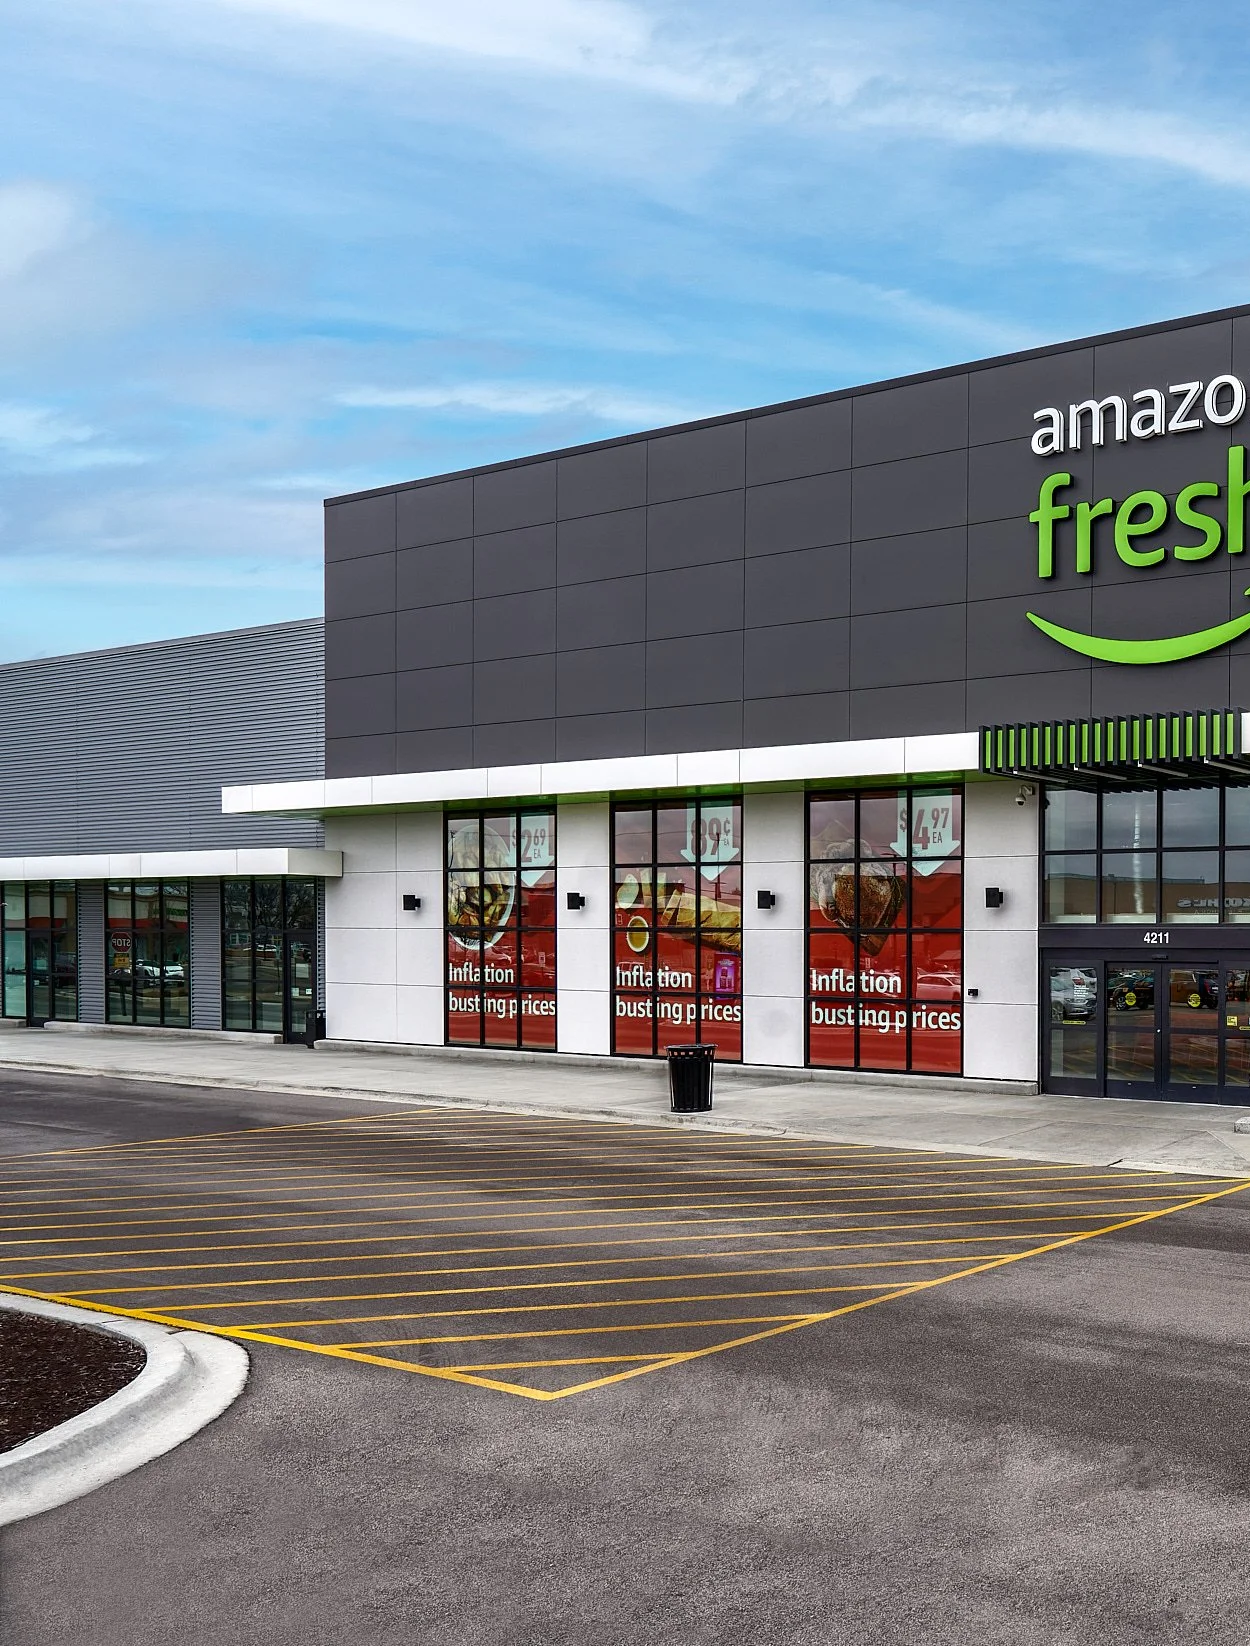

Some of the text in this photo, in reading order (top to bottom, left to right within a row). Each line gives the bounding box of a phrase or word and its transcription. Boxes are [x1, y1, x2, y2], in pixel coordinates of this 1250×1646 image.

[932, 831, 943, 844] EA
[1143, 931, 1169, 944] 4211
[448, 961, 514, 984] Inflation
[616, 965, 693, 988] Inflation
[811, 968, 902, 994] Inflation
[448, 991, 556, 1020] busting prices
[615, 995, 742, 1025] busting prices
[811, 1001, 962, 1034] busting prices
